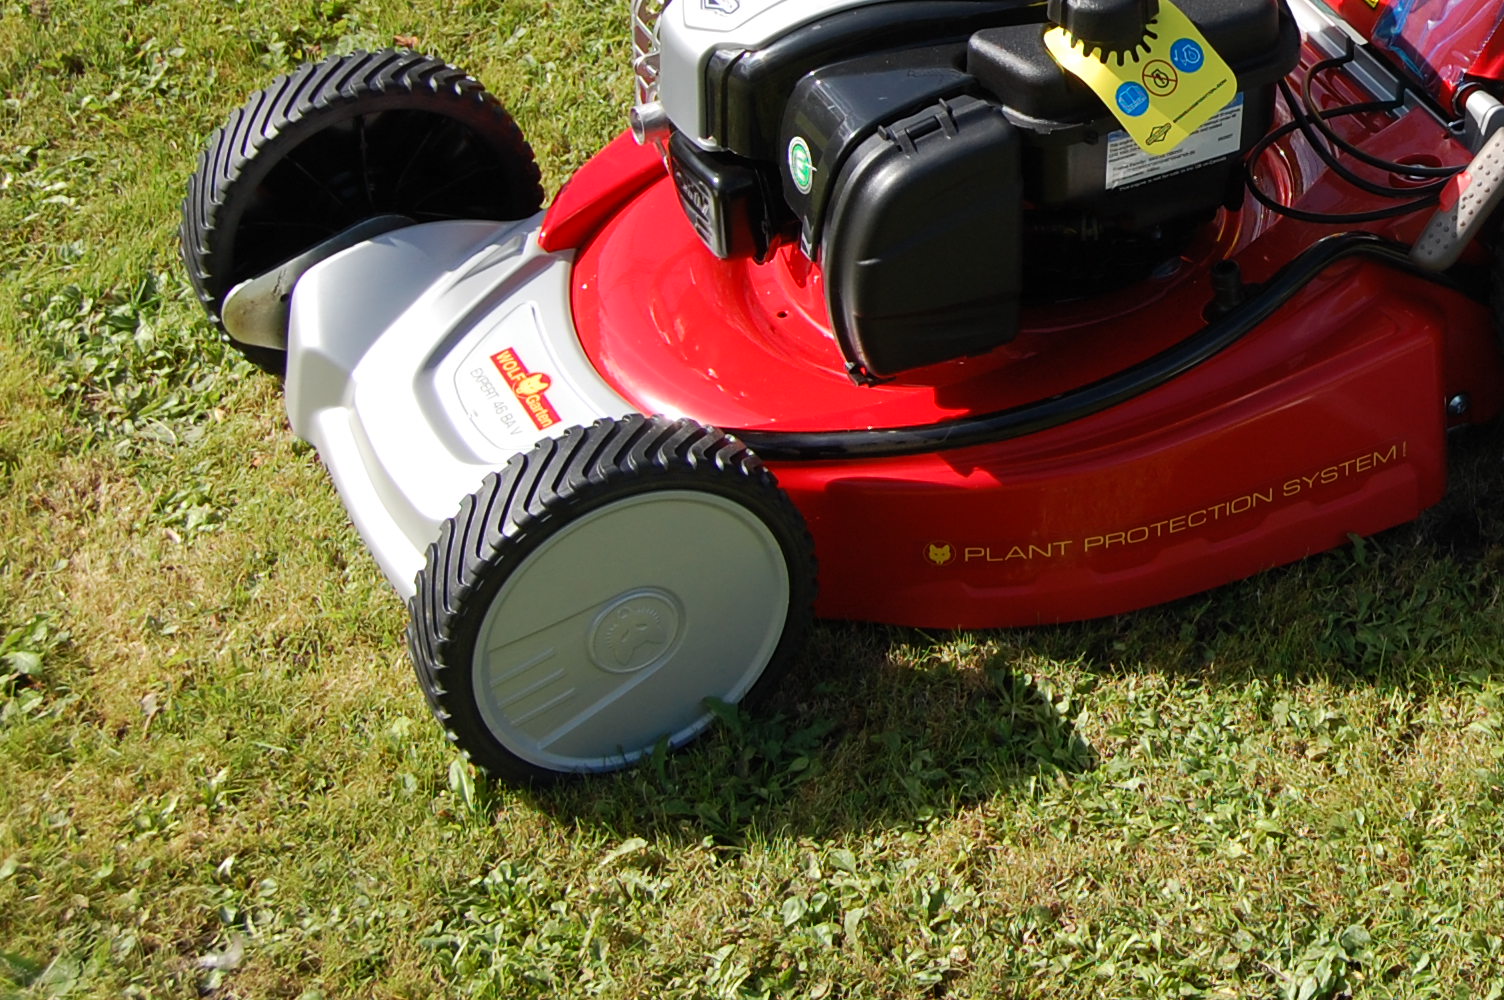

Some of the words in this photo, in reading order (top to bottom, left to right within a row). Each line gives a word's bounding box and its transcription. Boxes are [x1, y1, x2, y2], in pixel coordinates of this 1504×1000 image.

[470, 367, 500, 400] EXPERT
[493, 401, 509, 415] 46
[496, 350, 527, 382] WOLF
[525, 395, 553, 428] Garten
[964, 540, 1073, 563] PLANT
[1084, 487, 1273, 553] PROTECTION
